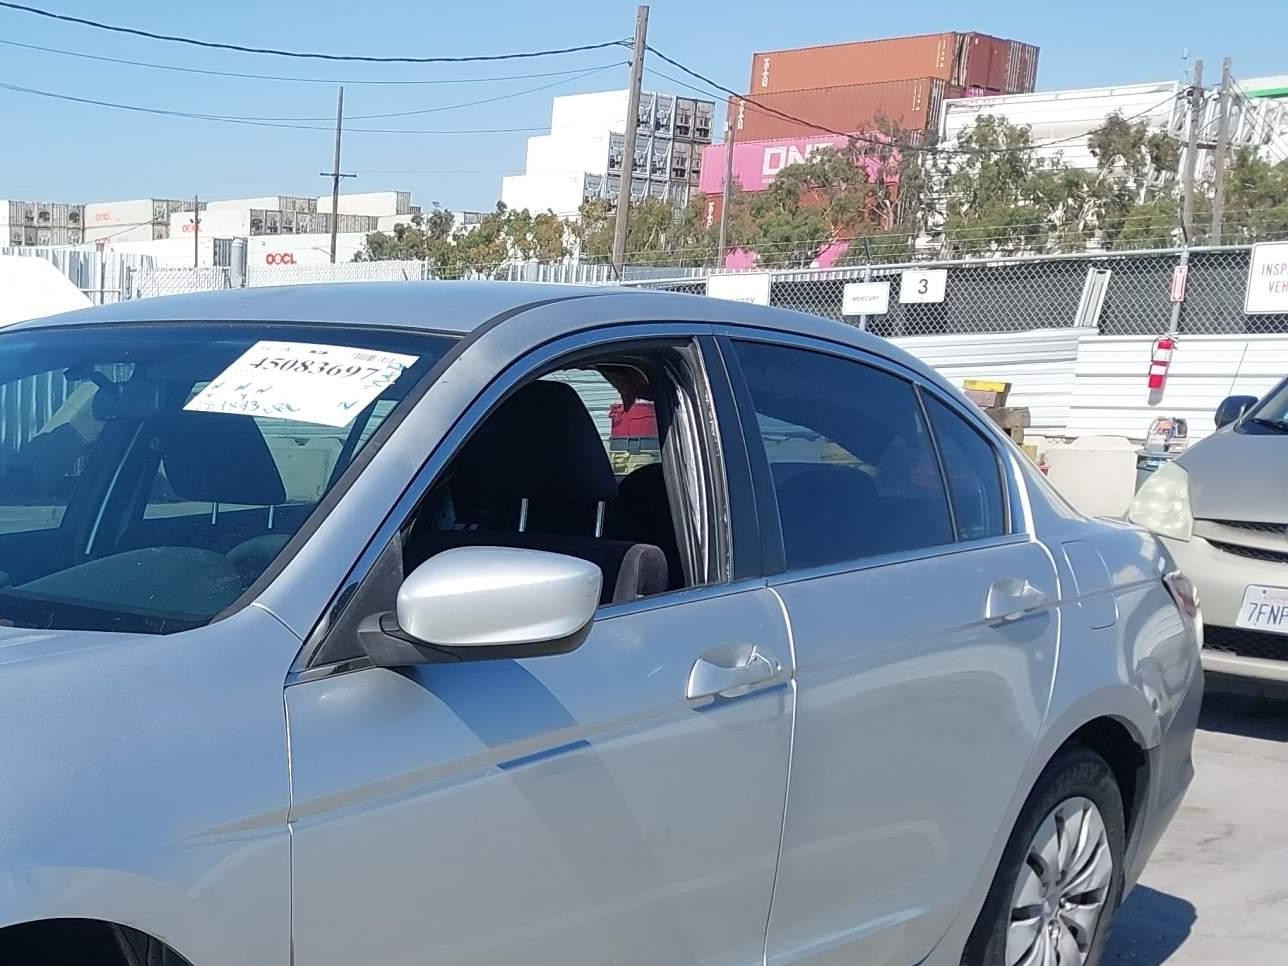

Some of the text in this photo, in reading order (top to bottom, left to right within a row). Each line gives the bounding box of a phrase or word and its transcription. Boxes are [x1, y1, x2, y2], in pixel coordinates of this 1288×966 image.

[266, 252, 297, 266] OOCL
[918, 279, 929, 295] 3
[249, 356, 380, 381] 45083697
